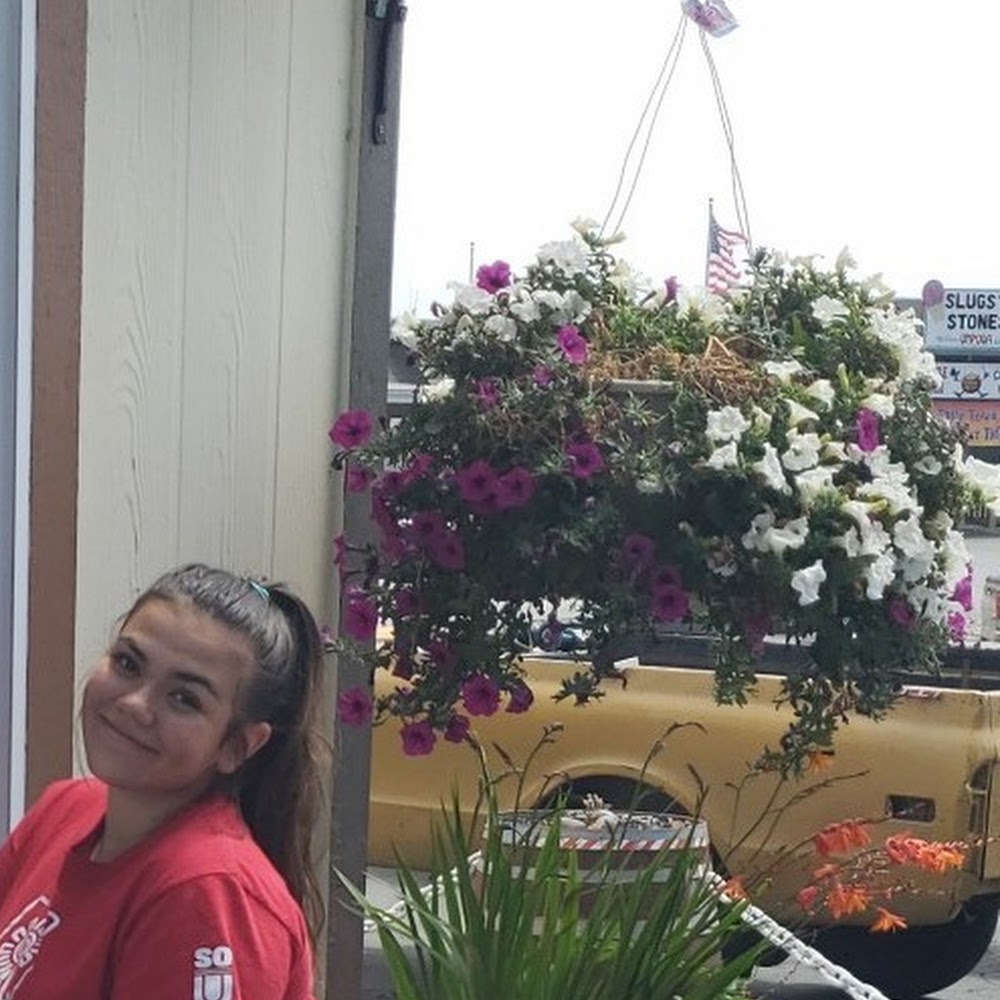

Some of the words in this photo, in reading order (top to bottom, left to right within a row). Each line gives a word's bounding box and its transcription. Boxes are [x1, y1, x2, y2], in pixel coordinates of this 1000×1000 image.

[945, 293, 996, 309] SLUGS
[947, 314, 1000, 329] STONE
[194, 945, 233, 968] SO
